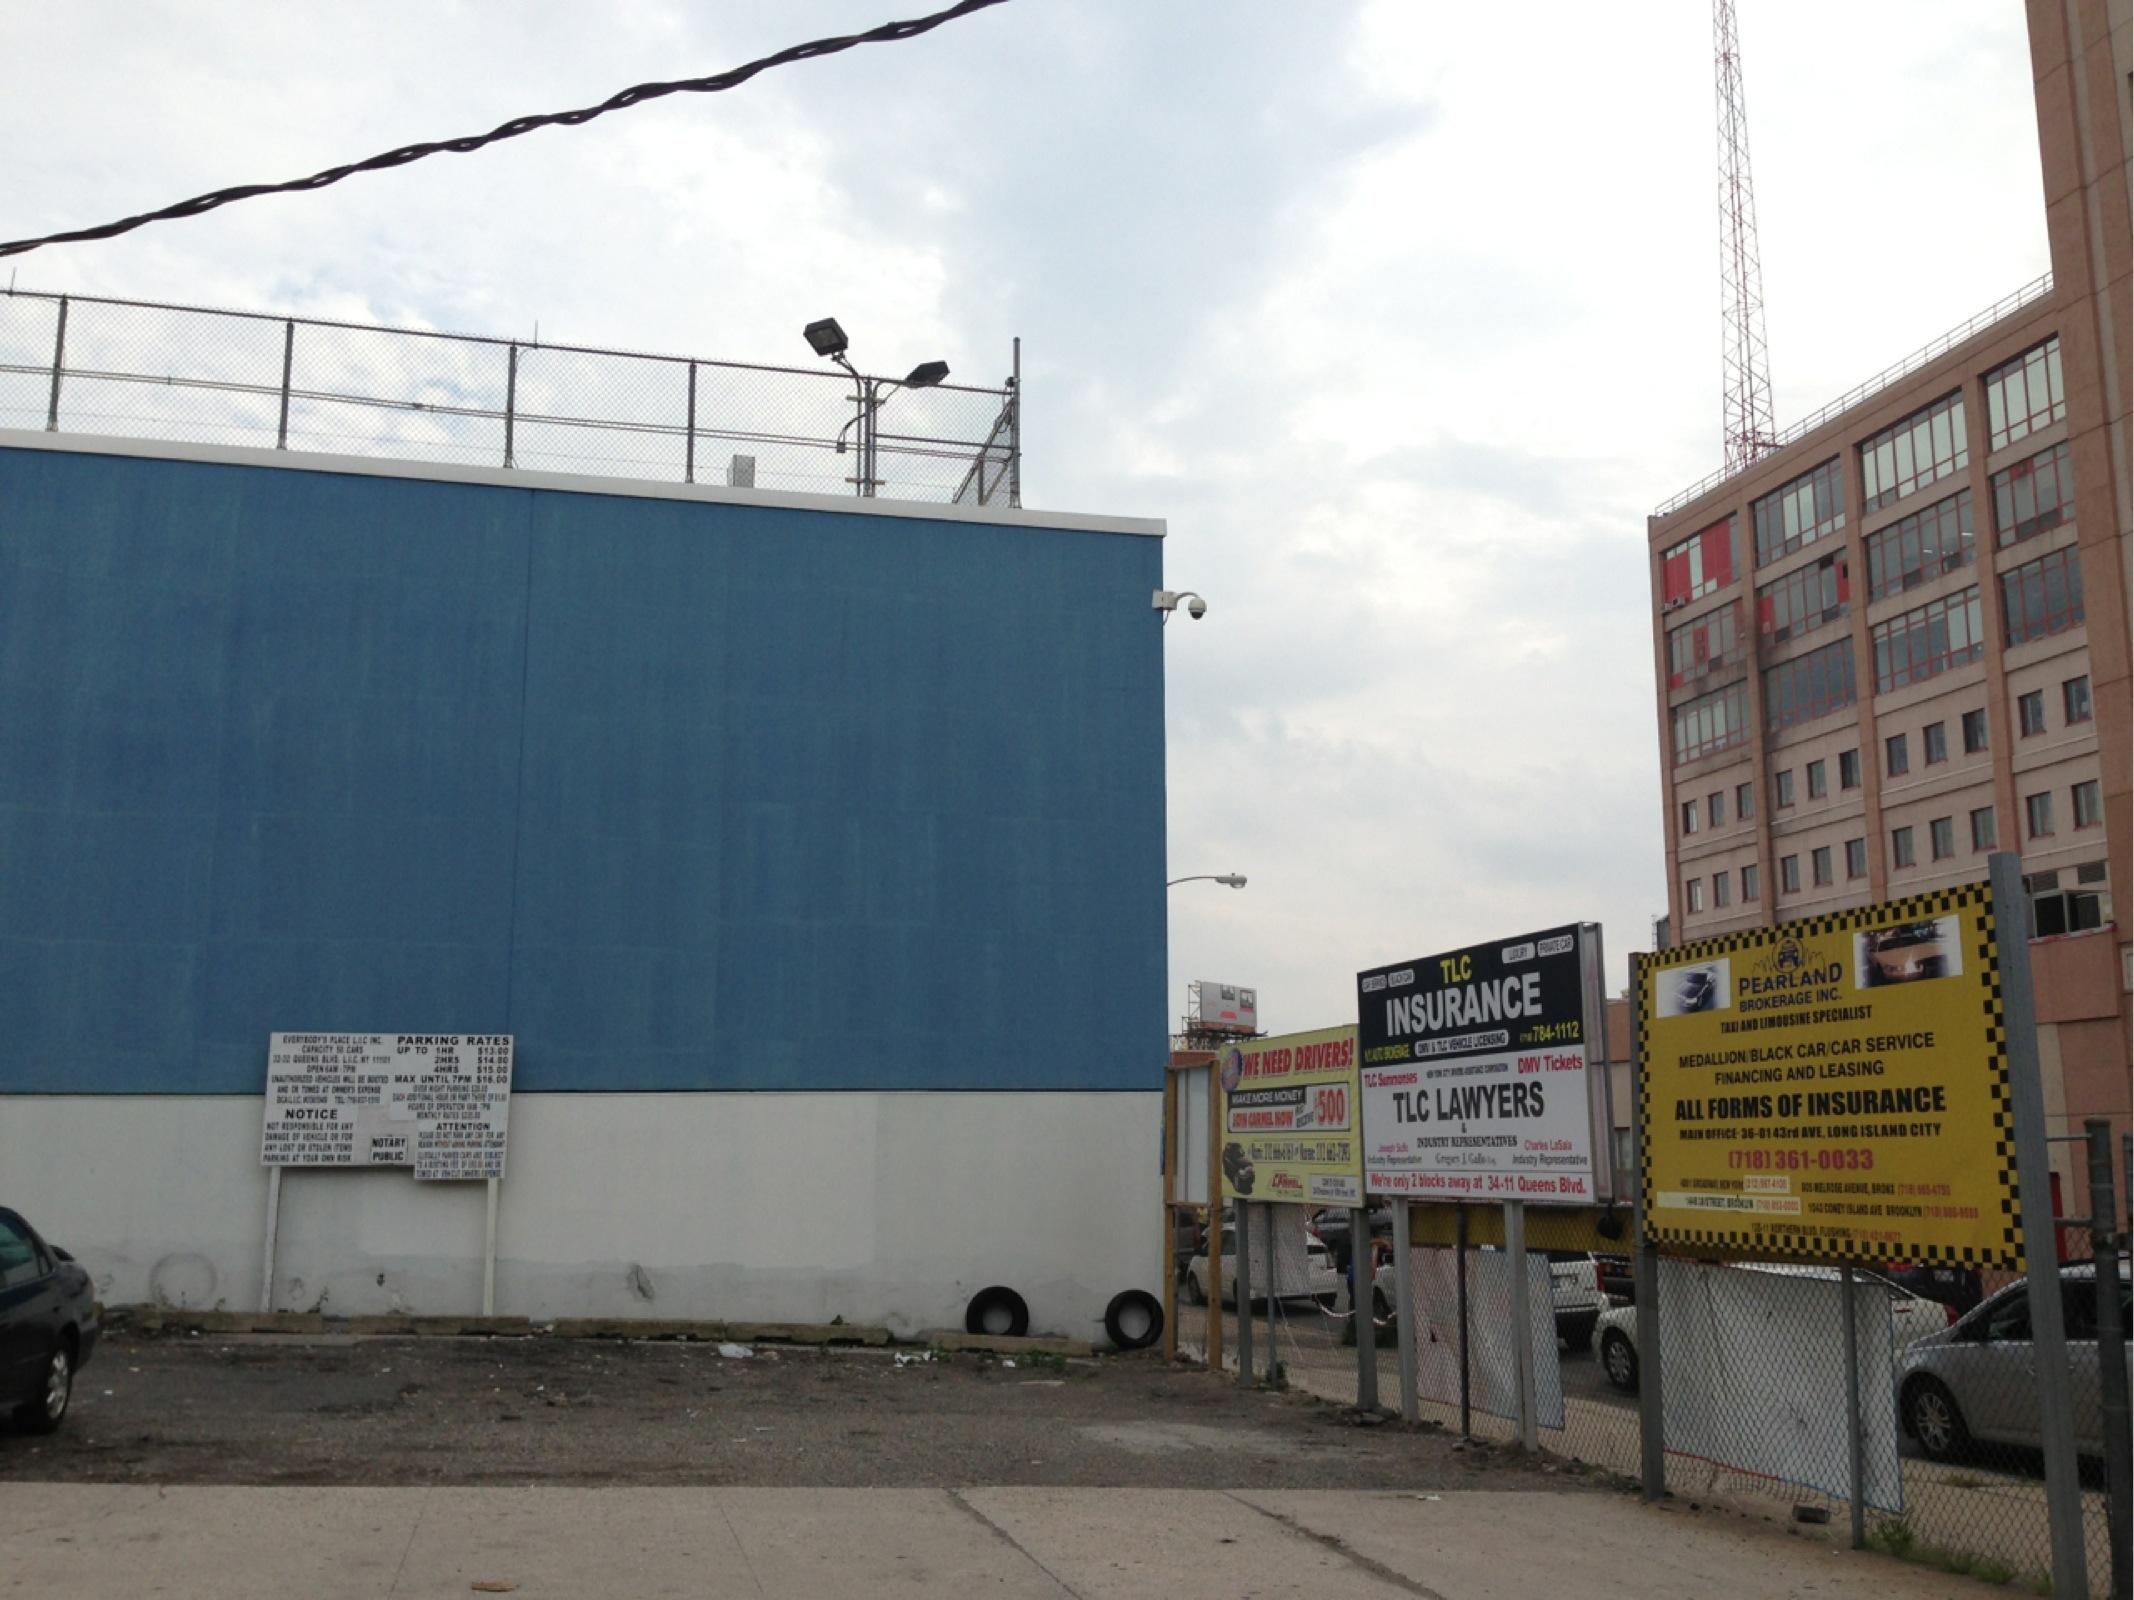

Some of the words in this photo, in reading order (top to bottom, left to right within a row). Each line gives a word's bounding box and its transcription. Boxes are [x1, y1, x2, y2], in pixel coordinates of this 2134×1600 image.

[1440, 955, 1472, 984] TLC
[1739, 962, 1842, 996] PEARLAND
[1386, 971, 1542, 1037] INSURANCE
[1740, 991, 1812, 1012] BROKERAGE
[1816, 988, 1842, 1002] INC.
[1721, 1021, 1739, 1033] TAXI
[1741, 1018, 1758, 1032] AND
[1760, 1012, 1810, 1029] LIMOUSINE
[1812, 1005, 1872, 1023] SPECIALIST
[1532, 1022, 1580, 1042] 784-1112
[330, 1036, 349, 1044] PLACE
[398, 1036, 458, 1045] PARKING
[467, 1037, 509, 1046] RATES
[1450, 1036, 1472, 1050] VEHICLE
[1474, 1032, 1506, 1048] LICENSING
[1866, 1032, 1935, 1052] SERVICE
[302, 1045, 333, 1054] CAPACITY
[347, 1046, 363, 1054] CARS
[397, 1046, 410, 1054] UP
[415, 1046, 428, 1054] TO
[293, 1055, 318, 1064] QUEENS
[434, 1056, 459, 1064] 2HRS
[1243, 1053, 1259, 1078] WE
[1262, 1048, 1291, 1075] NEED
[1295, 1038, 1354, 1072] DRIVERS!
[1518, 1056, 1540, 1074] DMV
[1544, 1054, 1582, 1072] Tickets
[307, 1065, 324, 1073] OPEN
[1715, 1068, 1782, 1085] FINANCING
[1786, 1065, 1815, 1080] AND
[1820, 1060, 1884, 1078] LEASING
[394, 1075, 416, 1083] MAX
[421, 1075, 449, 1083] UNTIL
[452, 1075, 472, 1083] 7PM
[1364, 1074, 1378, 1088] TLC
[1232, 1092, 1250, 1104] MAKE
[1252, 1091, 1272, 1103] MORE
[1274, 1090, 1303, 1102] MONEY
[1392, 1090, 1430, 1123] TLC
[1436, 1081, 1544, 1121] LAWYERS
[1675, 1099, 1704, 1120] ALL
[1708, 1095, 1772, 1119] FORMS
[1778, 1093, 1803, 1117] OF
[1808, 1086, 1946, 1116] INSURANCE
[285, 1109, 338, 1120] NOTICE
[1274, 1112, 1293, 1127] NOW
[326, 1122, 338, 1130] FOR
[342, 1122, 353, 1130] ANY
[436, 1122, 490, 1131] ATTENTION
[1680, 1128, 1703, 1140] MAIN
[1741, 1127, 1771, 1139] 36-01
[1773, 1127, 1798, 1138] 43rd
[1828, 1125, 1857, 1138] LONG
[1862, 1124, 1907, 1137] ISLAND
[1911, 1123, 1941, 1136] CITY
[372, 1138, 405, 1148] NOTARY
[1417, 1137, 1448, 1148] INDUSTRY
[1451, 1135, 1518, 1148] REPRESENTATIVES
[1524, 1140, 1548, 1151] Charles
[373, 1151, 404, 1161] PUBLIC
[1512, 1153, 1537, 1167] Industry
[1540, 1153, 1588, 1166] Representative
[1728, 1150, 1771, 1169] (718)
[1775, 1149, 1873, 1170] 361-0033
[1370, 1172, 1392, 1187] We're
[1393, 1174, 1408, 1190] only
[1411, 1173, 1417, 1187] 2
[1420, 1172, 1446, 1188] blocks
[1448, 1176, 1470, 1192] away
[1472, 1175, 1482, 1189] at
[1488, 1174, 1514, 1191] 34-11
[1518, 1176, 1556, 1192] Queens
[1560, 1176, 1587, 1194] Blvd.
